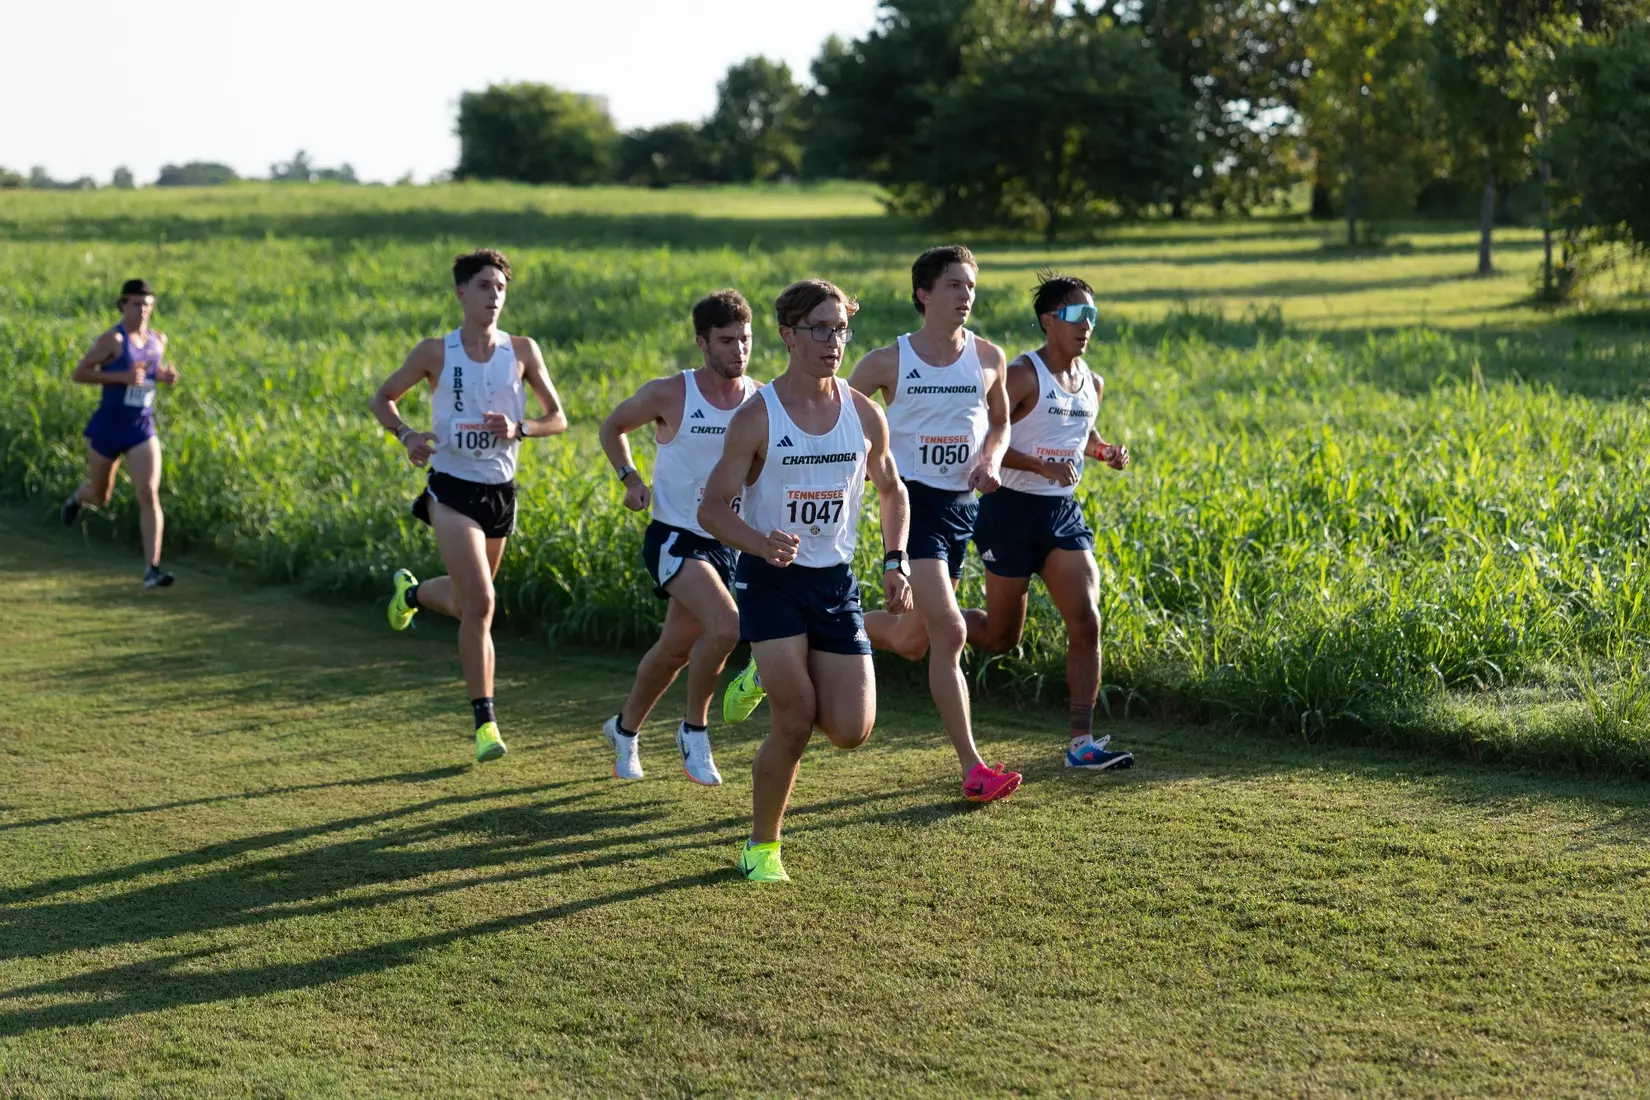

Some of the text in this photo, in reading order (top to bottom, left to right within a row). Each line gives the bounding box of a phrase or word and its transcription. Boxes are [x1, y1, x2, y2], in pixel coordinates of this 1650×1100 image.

[453, 367, 463, 412] BBTC
[907, 385, 977, 395] CHATTANOOGA
[690, 425, 726, 434] CHATTA
[454, 431, 498, 450] 1087
[920, 435, 969, 444] TENNESSEE
[918, 444, 970, 466] 1050
[1036, 446, 1076, 457] TENNESSEE
[782, 452, 857, 466] CHATTANOOGA
[787, 490, 844, 500] TENNESSEE
[786, 499, 844, 525] 1047
